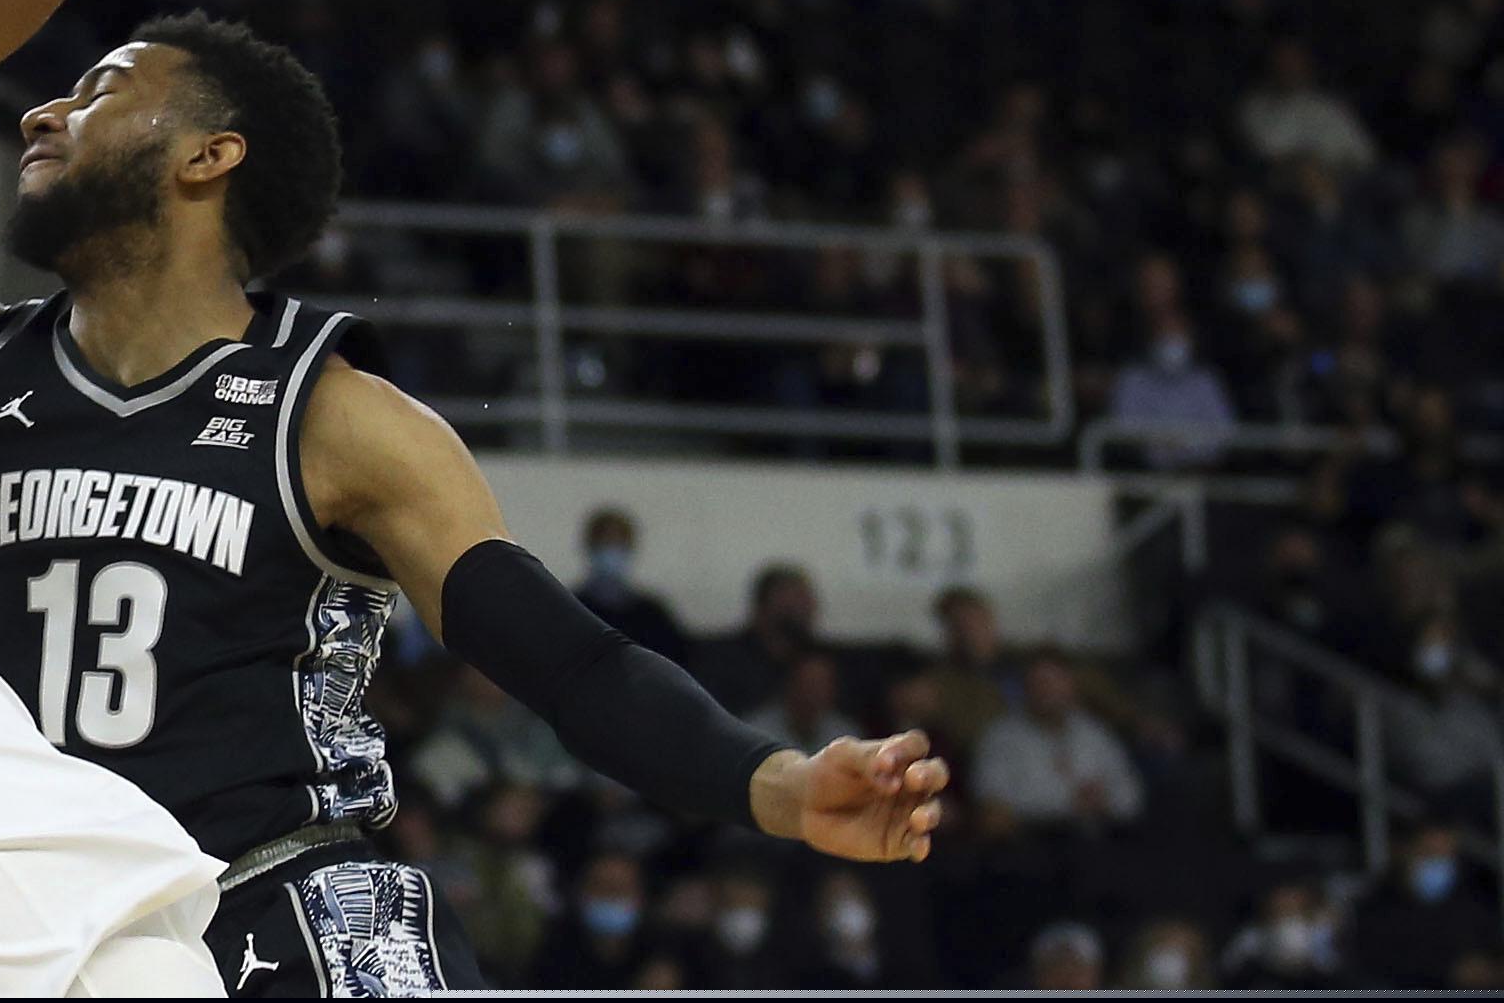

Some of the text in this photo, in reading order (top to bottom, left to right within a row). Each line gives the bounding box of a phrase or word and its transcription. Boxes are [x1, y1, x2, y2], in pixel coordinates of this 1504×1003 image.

[231, 376, 261, 393] BE
[215, 388, 276, 405] CHANGE
[206, 417, 247, 431] BIG
[197, 429, 255, 445] EAST
[27, 559, 169, 750] 13
